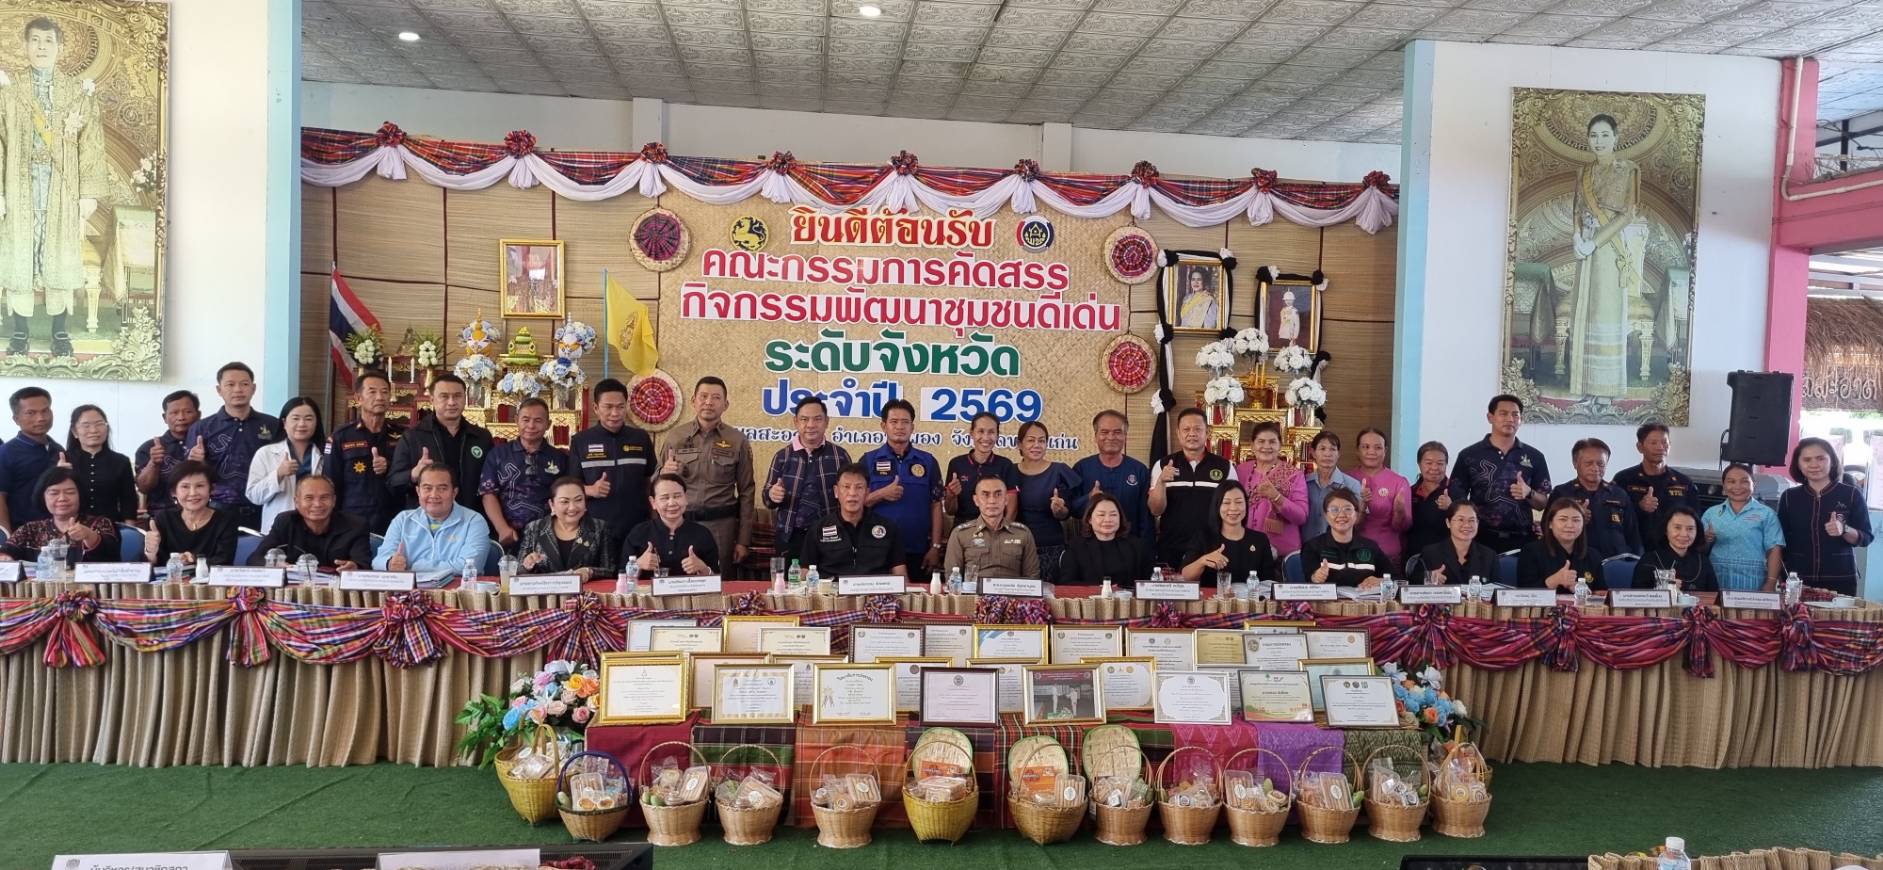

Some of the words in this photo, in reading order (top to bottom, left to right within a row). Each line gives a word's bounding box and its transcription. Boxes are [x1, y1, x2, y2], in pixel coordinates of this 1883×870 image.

[793, 206, 993, 247] ยินดีต้อนรับ
[703, 250, 1069, 290] คณะกรรมการคัดสรร
[683, 283, 1121, 337] กิจกรรมพัฒนาชุมชนดีเด่น
[767, 330, 1020, 375] ระดับจังหวัด
[931, 388, 1041, 422] 2569
